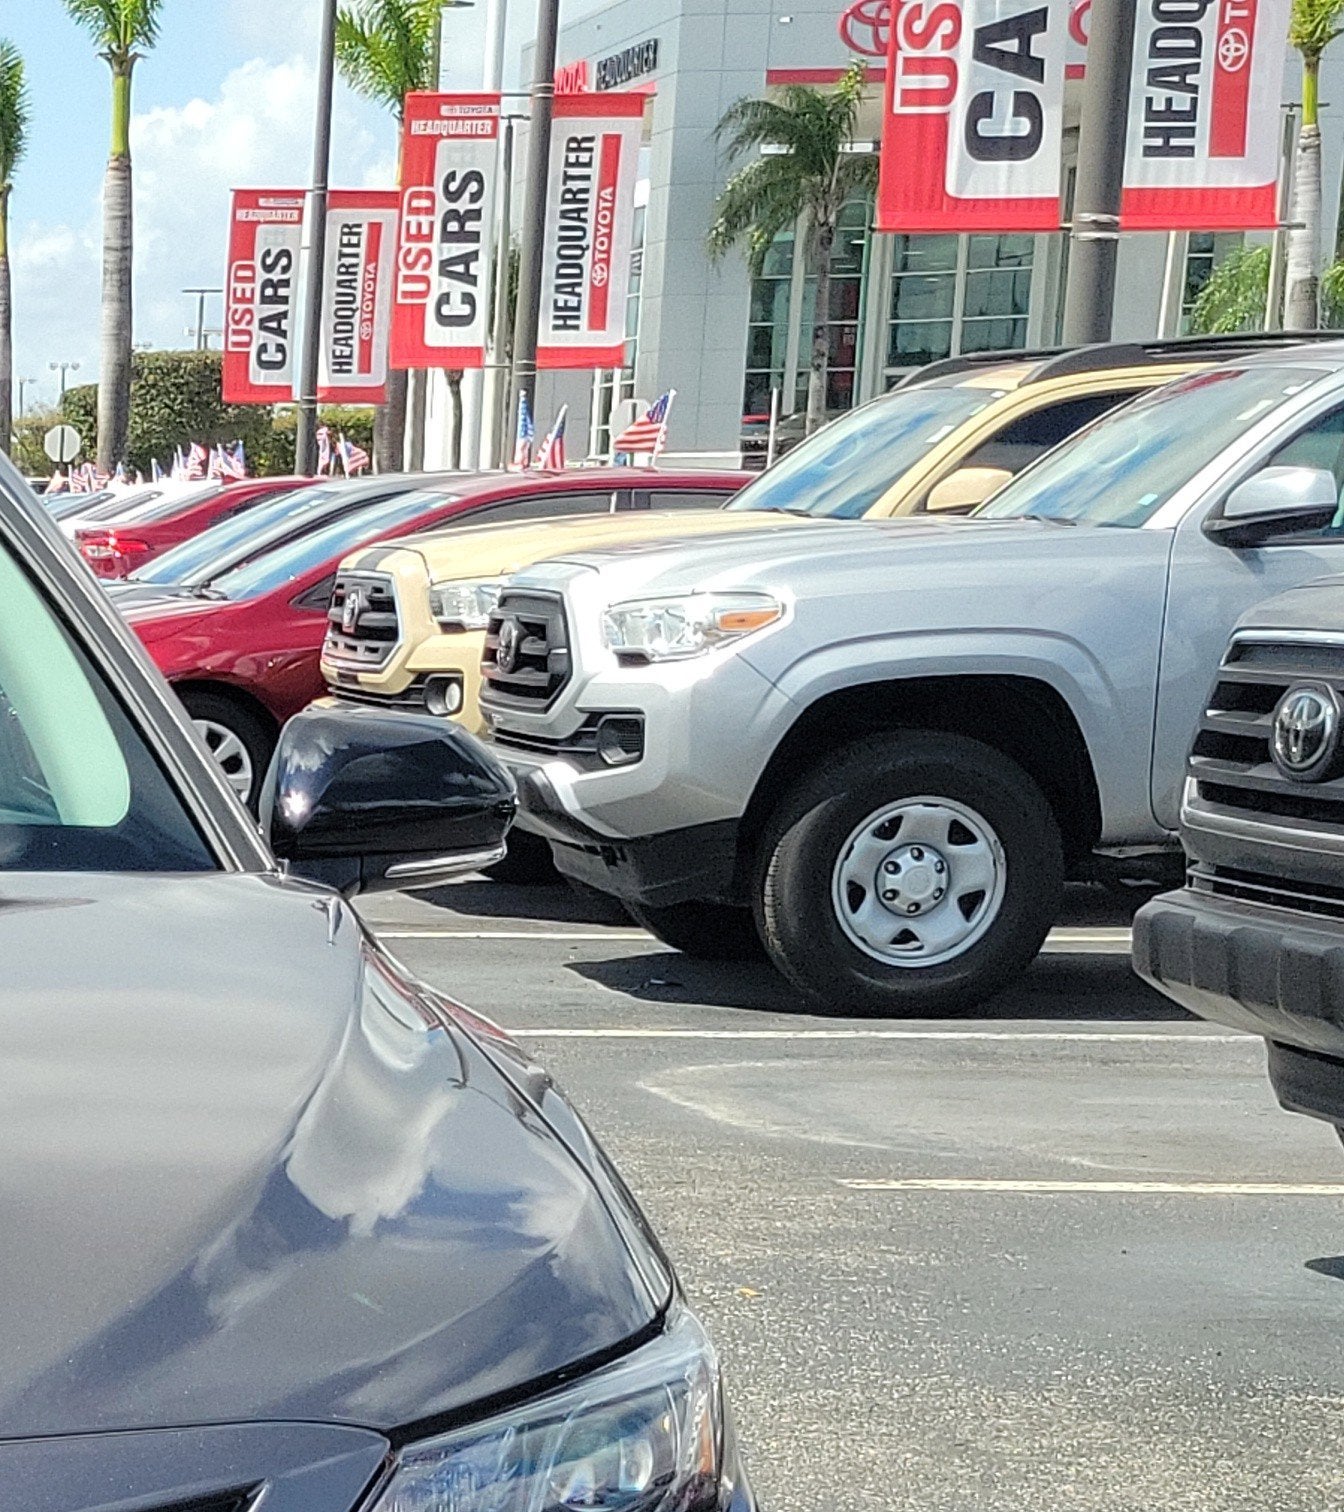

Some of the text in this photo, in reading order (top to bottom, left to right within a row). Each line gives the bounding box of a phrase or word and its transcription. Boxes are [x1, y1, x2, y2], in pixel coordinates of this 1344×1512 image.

[899, 0, 963, 111] US
[965, 6, 1049, 162] CA
[401, 191, 436, 300] USED
[435, 170, 485, 327] CARS
[552, 135, 595, 331] HEADQUARTER
[593, 187, 613, 260] TOYOTA
[231, 266, 256, 349] USED
[257, 248, 292, 370] CARS
[332, 223, 362, 374] HEADQUARTER
[362, 262, 376, 320] TOYOTA
